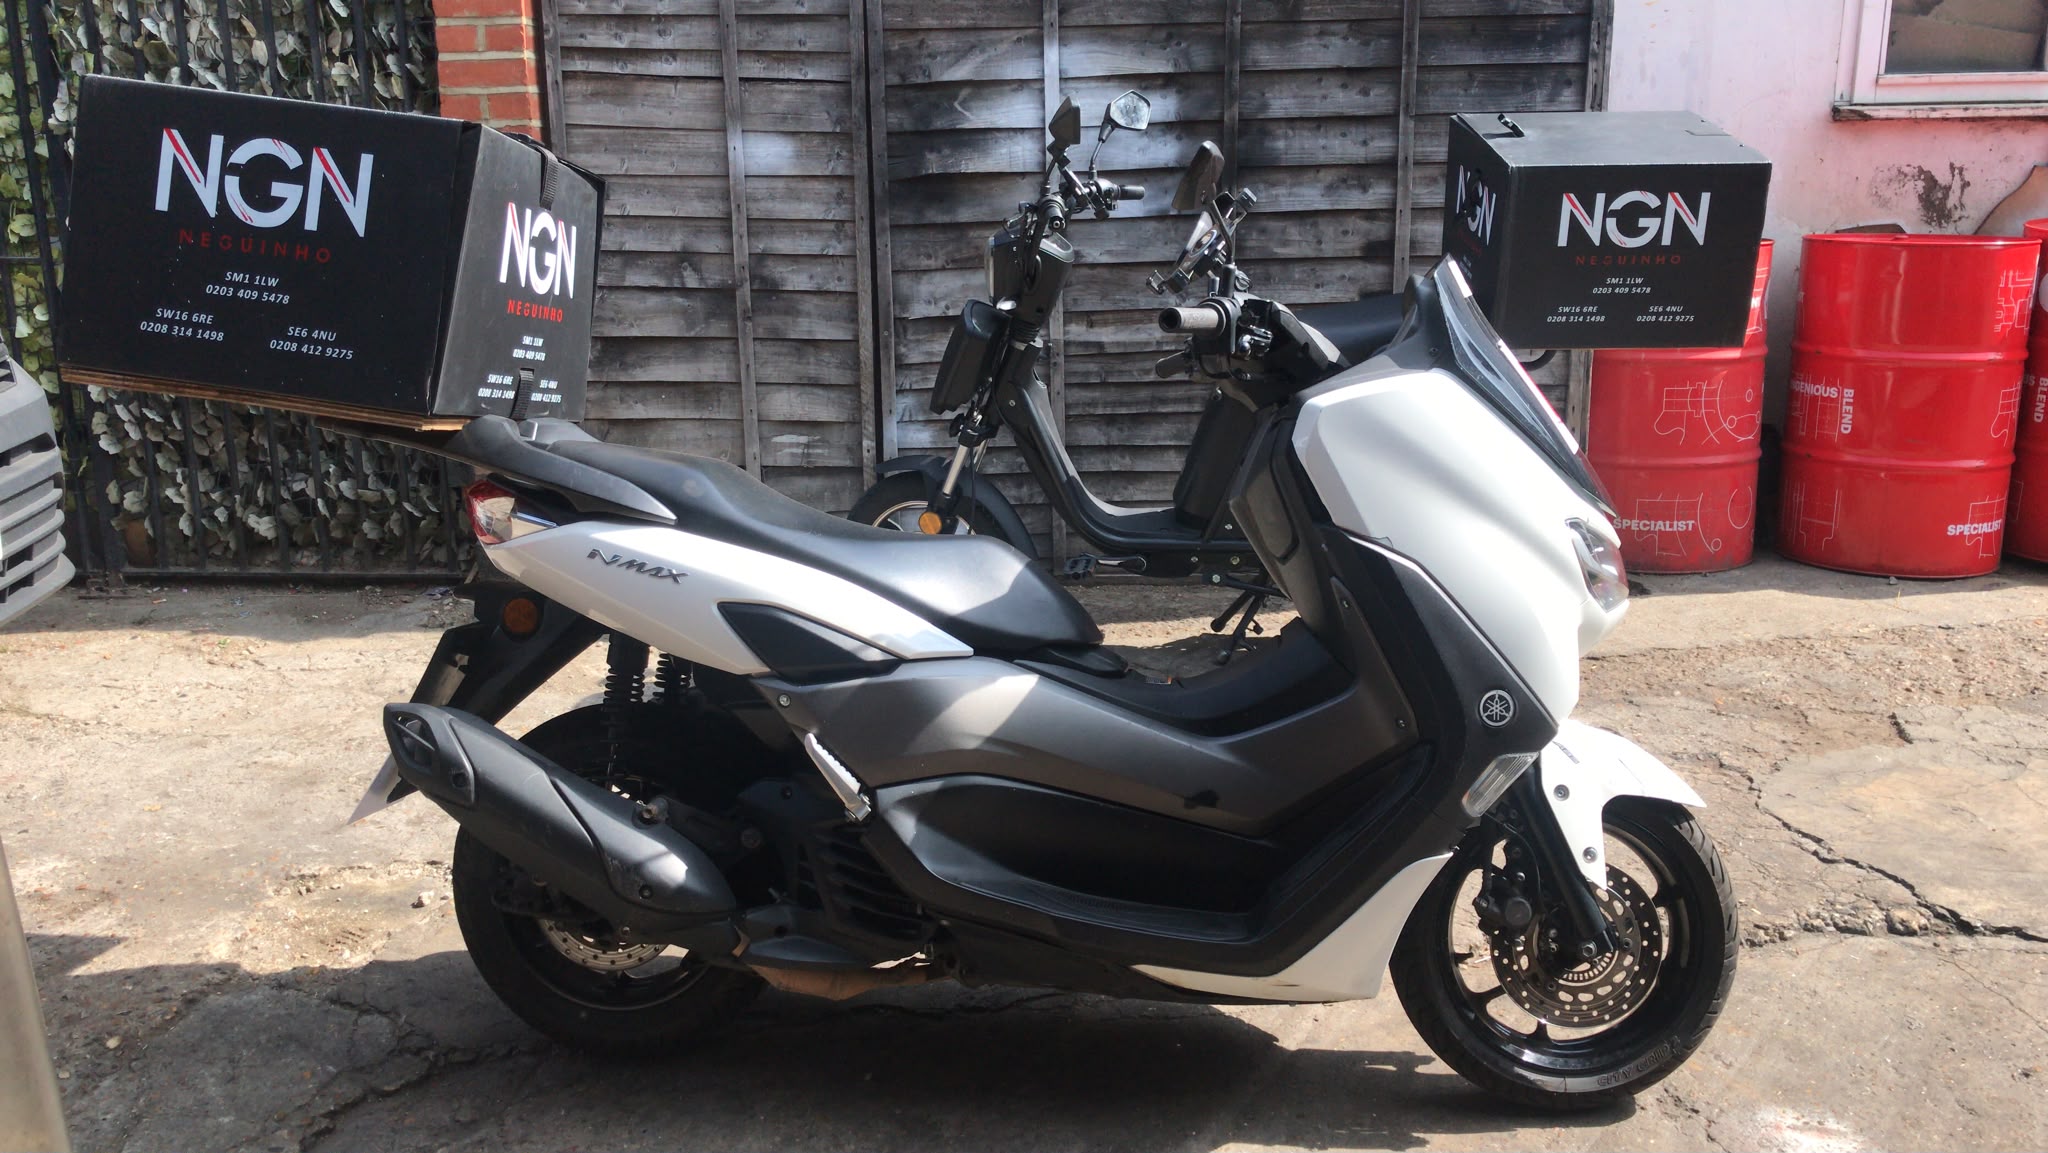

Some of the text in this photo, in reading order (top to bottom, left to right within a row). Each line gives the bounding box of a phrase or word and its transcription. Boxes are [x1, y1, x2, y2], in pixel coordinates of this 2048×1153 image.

[155, 128, 374, 237] NGN
[1557, 190, 1711, 248] NGN
[178, 229, 331, 263] NEGUINHO
[499, 202, 577, 299] NGN
[1575, 255, 1681, 266] NEGUINHO
[225, 271, 280, 288] SM1 1LW
[1606, 277, 1644, 285] SM1 1LW
[205, 284, 290, 305] 0203 409 5478
[155, 308, 214, 325] SW16 6RE
[507, 299, 563, 322] NEGUINHO
[140, 321, 224, 342] 0208 314 1498
[287, 326, 337, 342] SE6 4NU
[269, 339, 353, 360] 0208 412 9275
[2034, 377, 2048, 422] BLEND
[1841, 388, 1854, 434] BLEND
[1613, 518, 1695, 531] SPECIALIST
[1947, 519, 2002, 536] SPECIALIST
[1597, 1064, 1633, 1087] CITY
